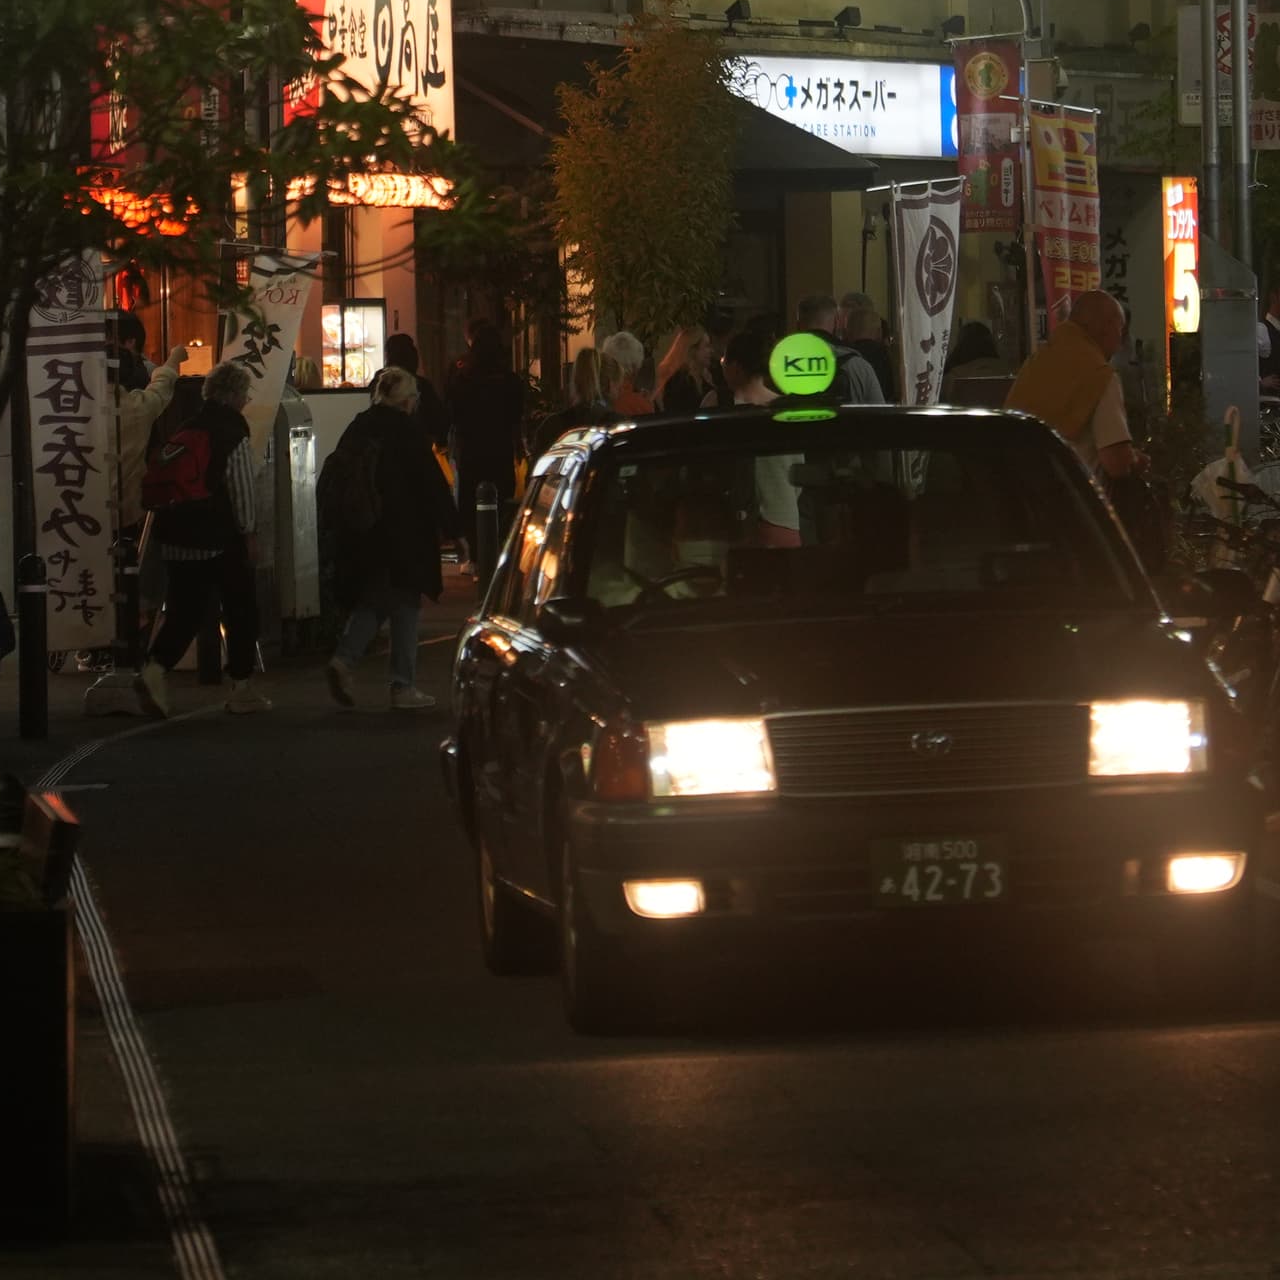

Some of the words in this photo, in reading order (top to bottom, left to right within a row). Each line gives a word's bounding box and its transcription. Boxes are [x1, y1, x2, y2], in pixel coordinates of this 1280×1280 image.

[800, 77, 897, 112] メガネスーパー
[833, 124, 877, 138] STATION
[942, 839, 978, 860] 500
[901, 862, 1004, 902] 42-73
